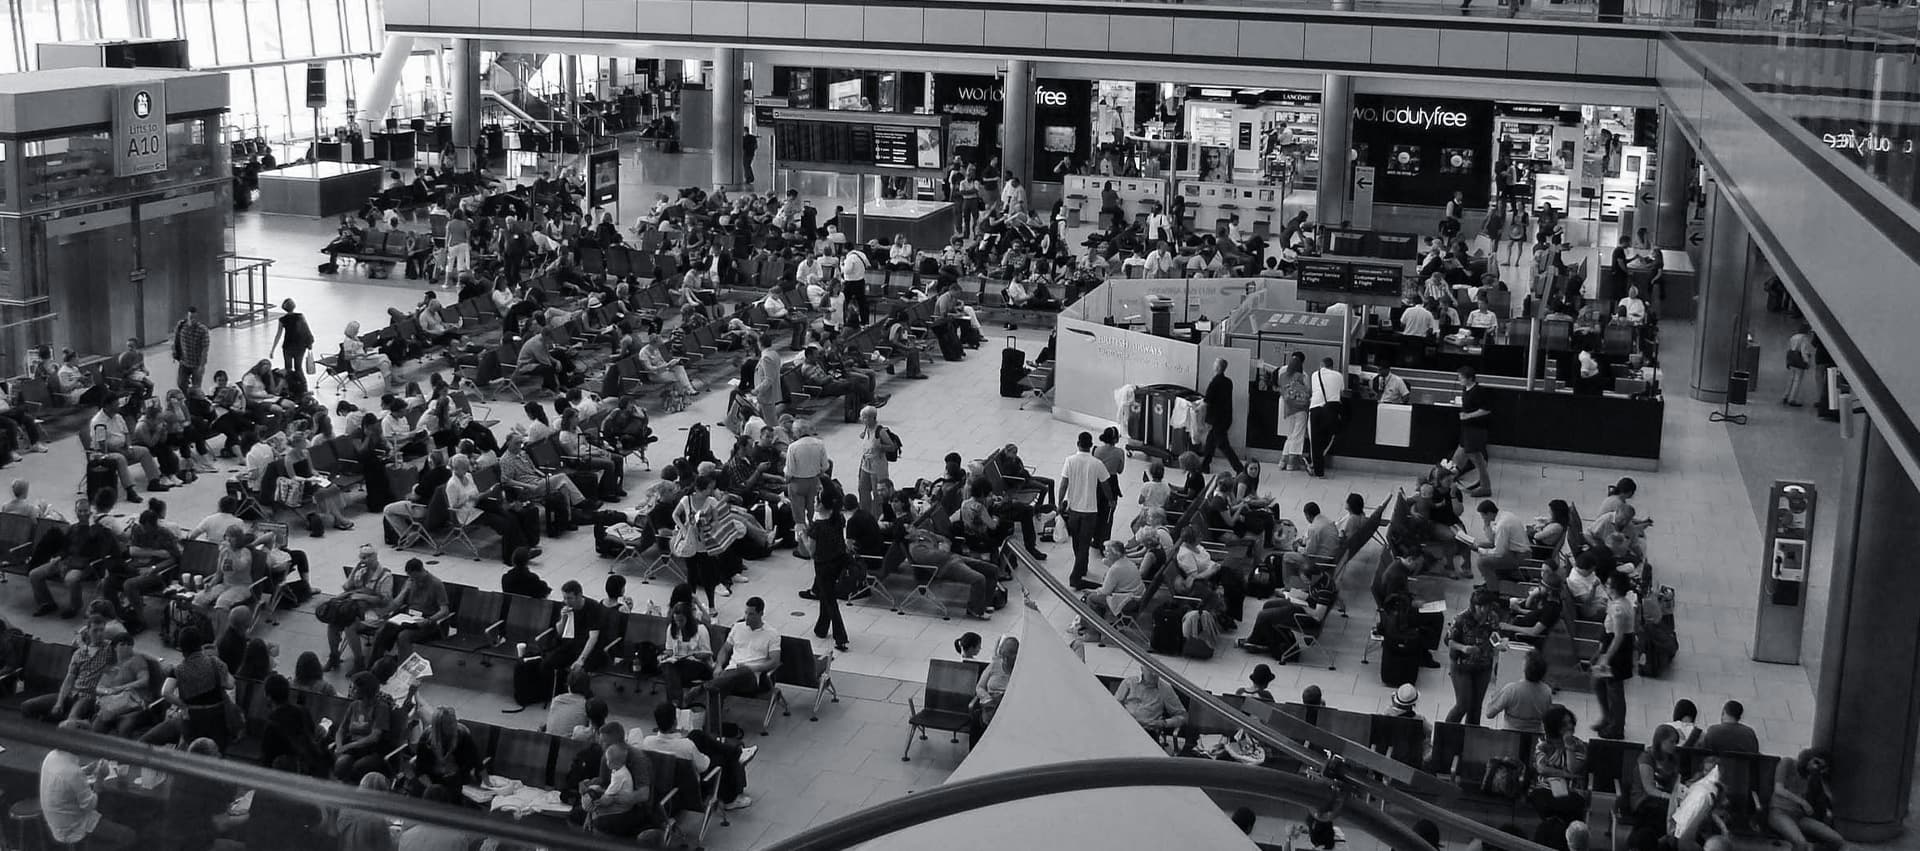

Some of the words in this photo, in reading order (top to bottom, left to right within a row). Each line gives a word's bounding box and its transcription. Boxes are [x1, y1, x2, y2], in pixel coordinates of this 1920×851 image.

[129, 125, 147, 134] Lifts
[148, 124, 157, 132] to
[127, 135, 159, 157] A10
